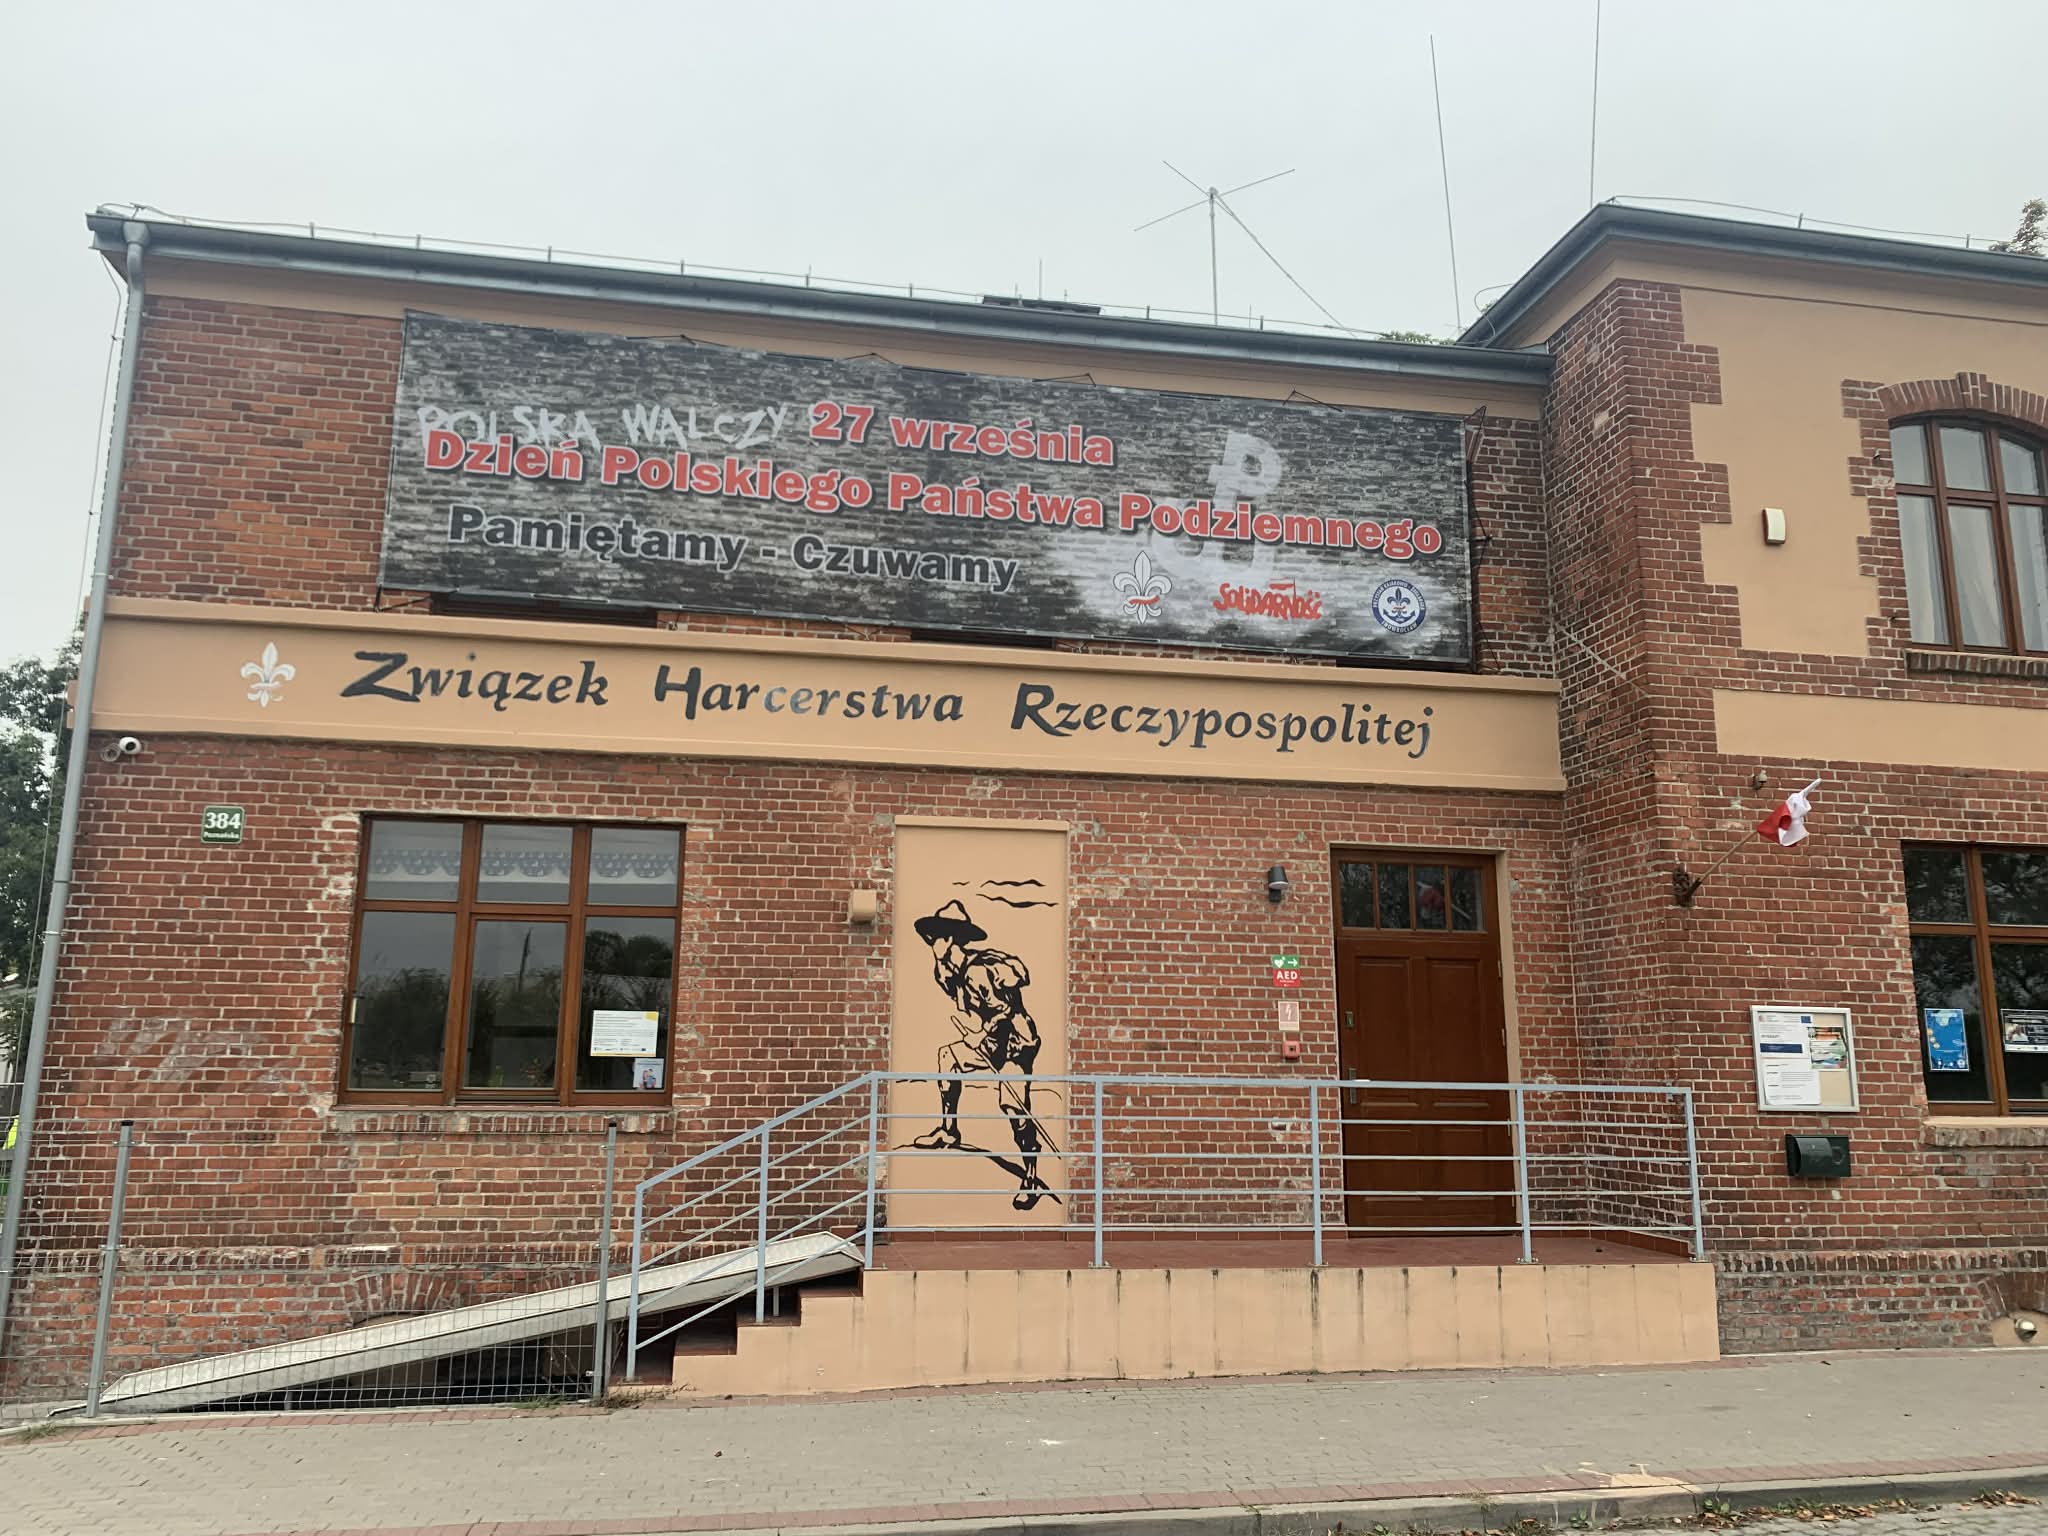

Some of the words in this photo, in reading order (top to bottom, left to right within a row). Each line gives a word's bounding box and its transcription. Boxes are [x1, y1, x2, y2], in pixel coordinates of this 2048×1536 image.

[622, 403, 787, 449] WALCZY
[809, 401, 874, 443] 27
[889, 416, 1114, 466] września
[424, 429, 584, 481] Dzień
[601, 445, 871, 513] Polskiego
[888, 472, 1104, 528] Państwa
[1119, 493, 1442, 559] Podziemnego
[449, 503, 746, 573] Pamiętamy
[792, 534, 1018, 593] Czuwamy
[340, 649, 609, 711] Związek
[654, 664, 965, 722] Harcerstwa
[1010, 683, 1434, 759] Rzeczypospolitej
[205, 812, 241, 829] 384
[1276, 970, 1298, 980] AED
